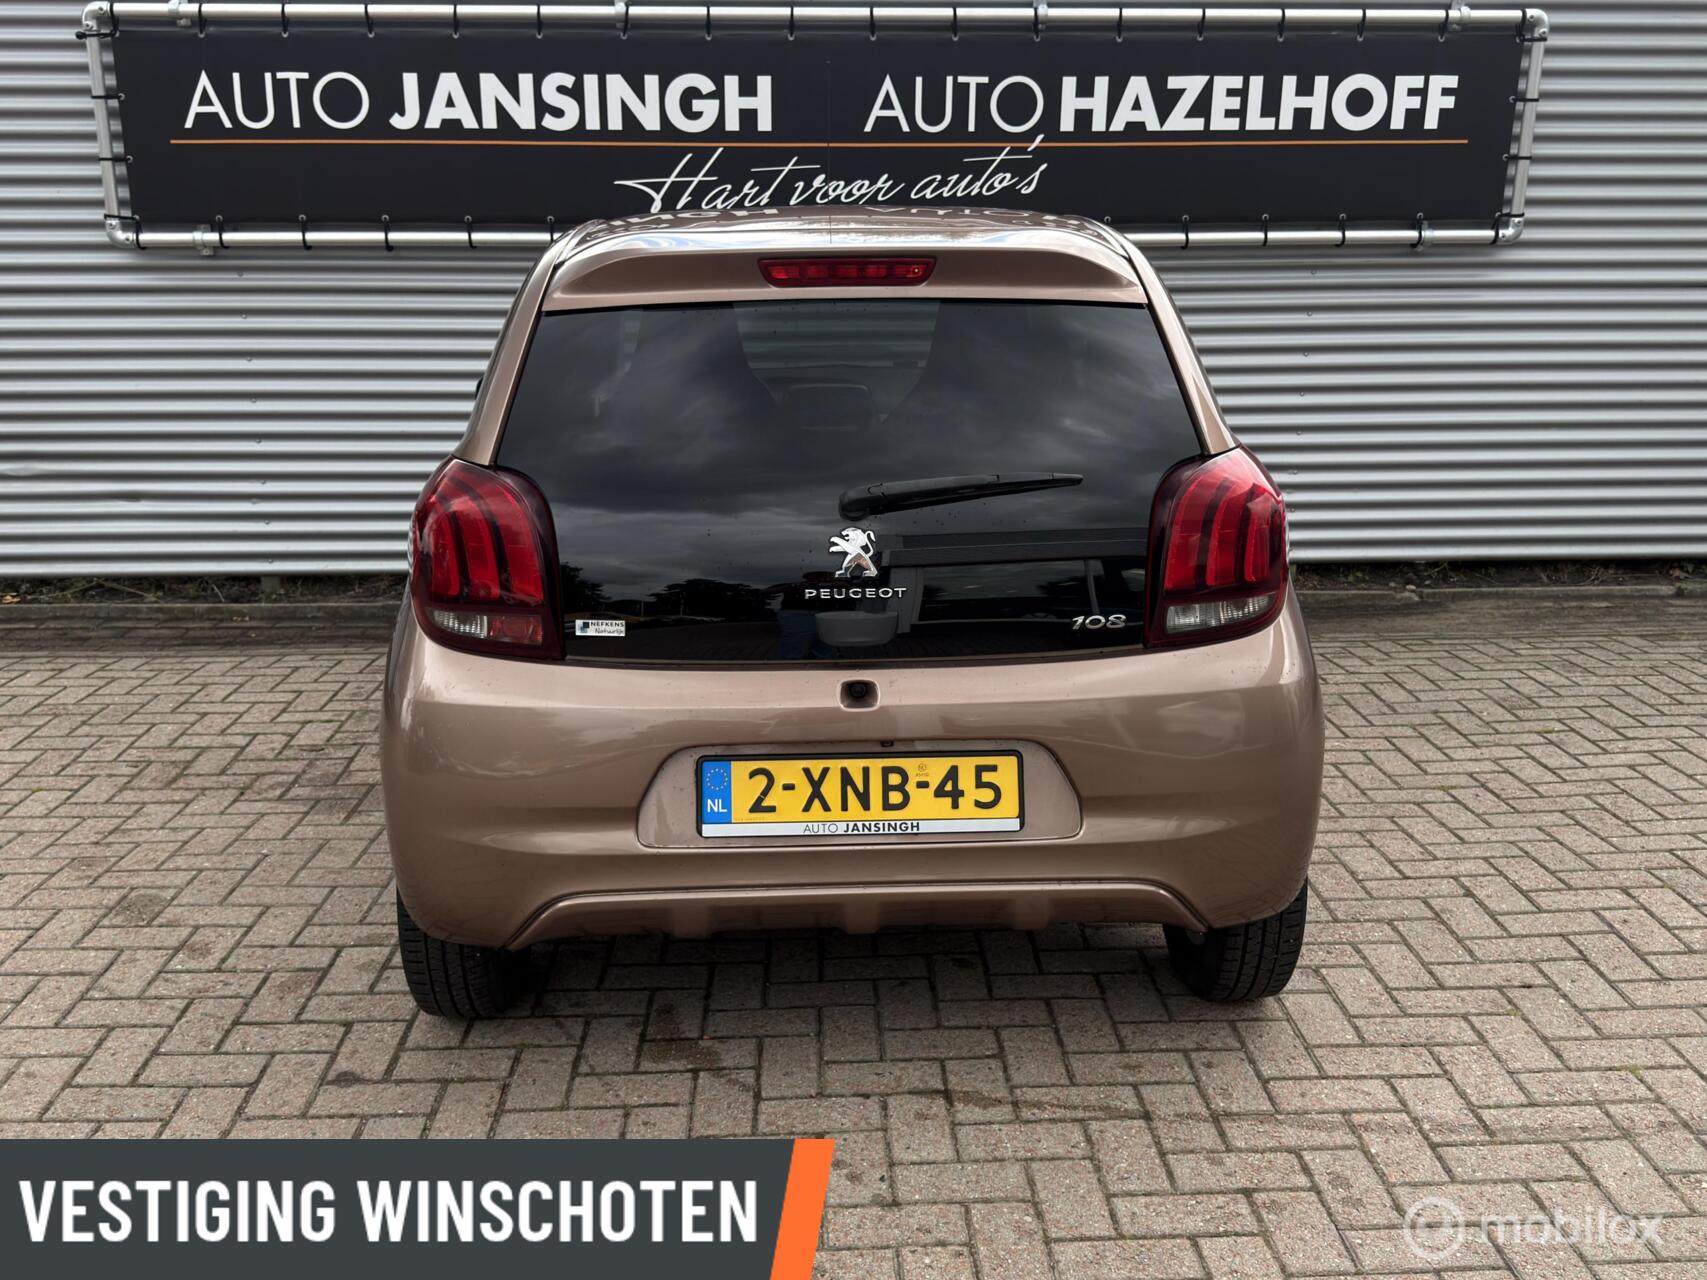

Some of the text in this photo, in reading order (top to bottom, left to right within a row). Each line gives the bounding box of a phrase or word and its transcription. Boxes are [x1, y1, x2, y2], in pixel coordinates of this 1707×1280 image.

[184, 70, 773, 132] AUTO JANSINGH
[864, 73, 1459, 133] AUTO HAZELHOFF
[613, 134, 1049, 214] Hart voor auto's
[804, 587, 907, 600] PEUGEOT
[1072, 614, 1127, 630] 108
[748, 764, 1002, 814] 2-XNB-45
[706, 798, 728, 814] NL
[803, 822, 920, 834] AUTO JANSINGH
